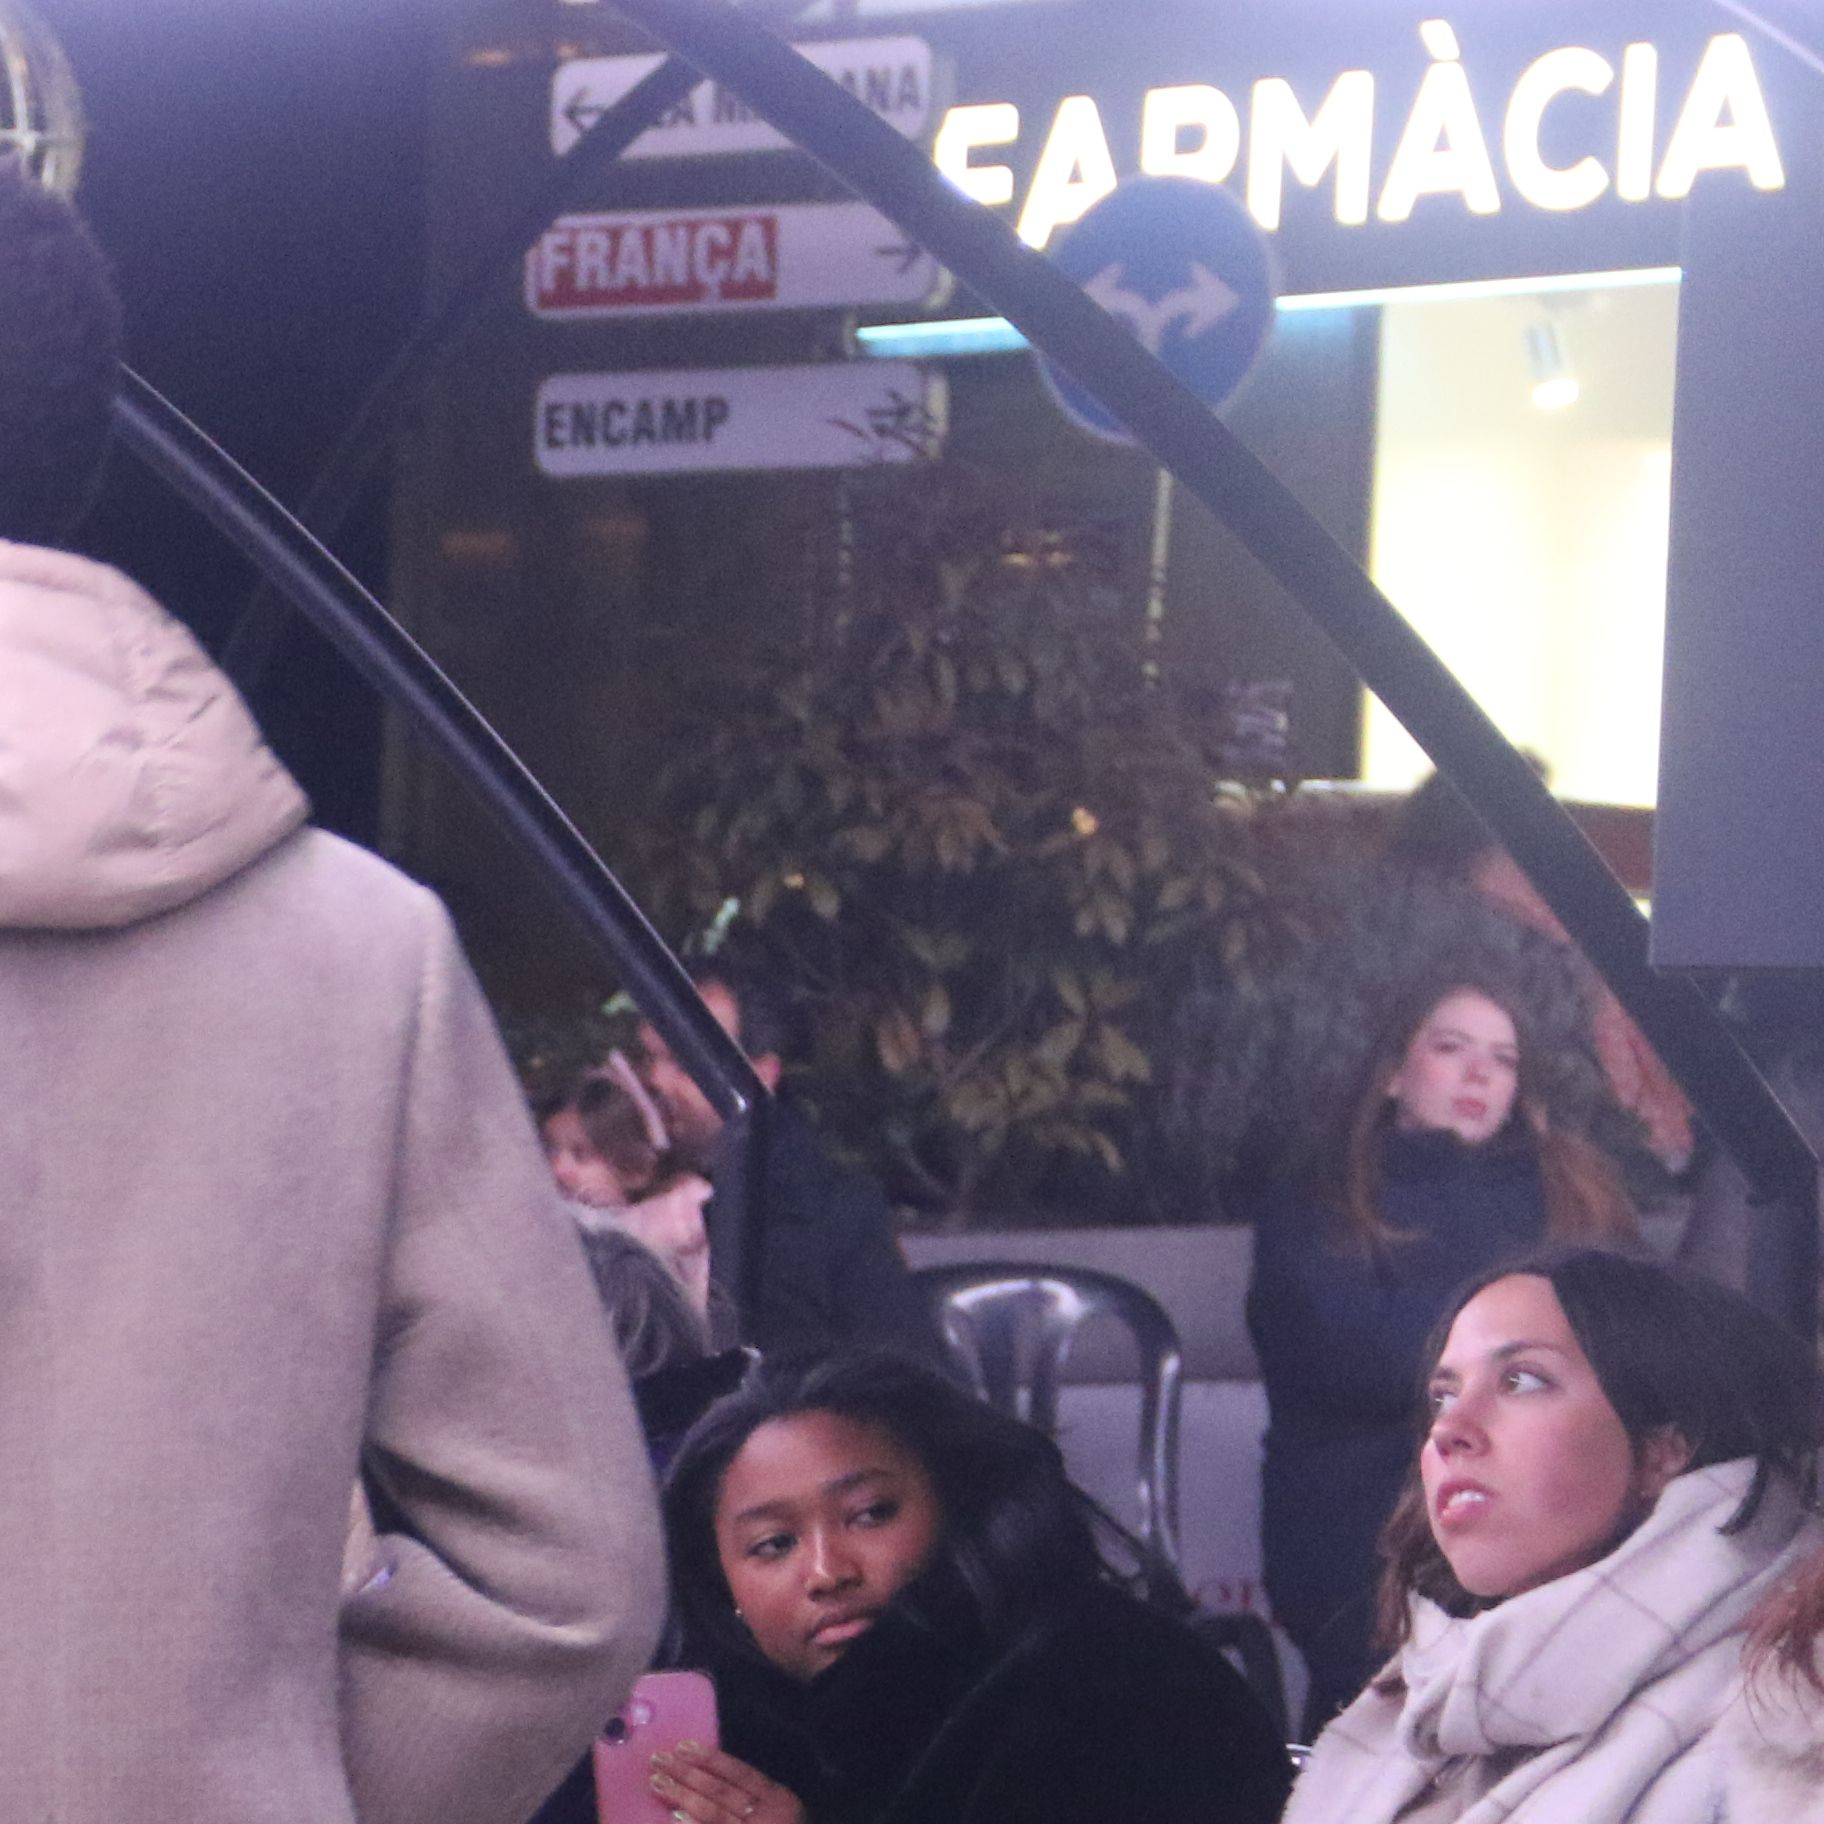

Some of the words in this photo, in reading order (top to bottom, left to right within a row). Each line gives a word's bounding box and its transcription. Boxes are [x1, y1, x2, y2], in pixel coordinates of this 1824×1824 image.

[934, 19, 1786, 250] FARMÀCIA
[540, 218, 773, 300] FRANÇA
[541, 397, 730, 448] ENCAMP
